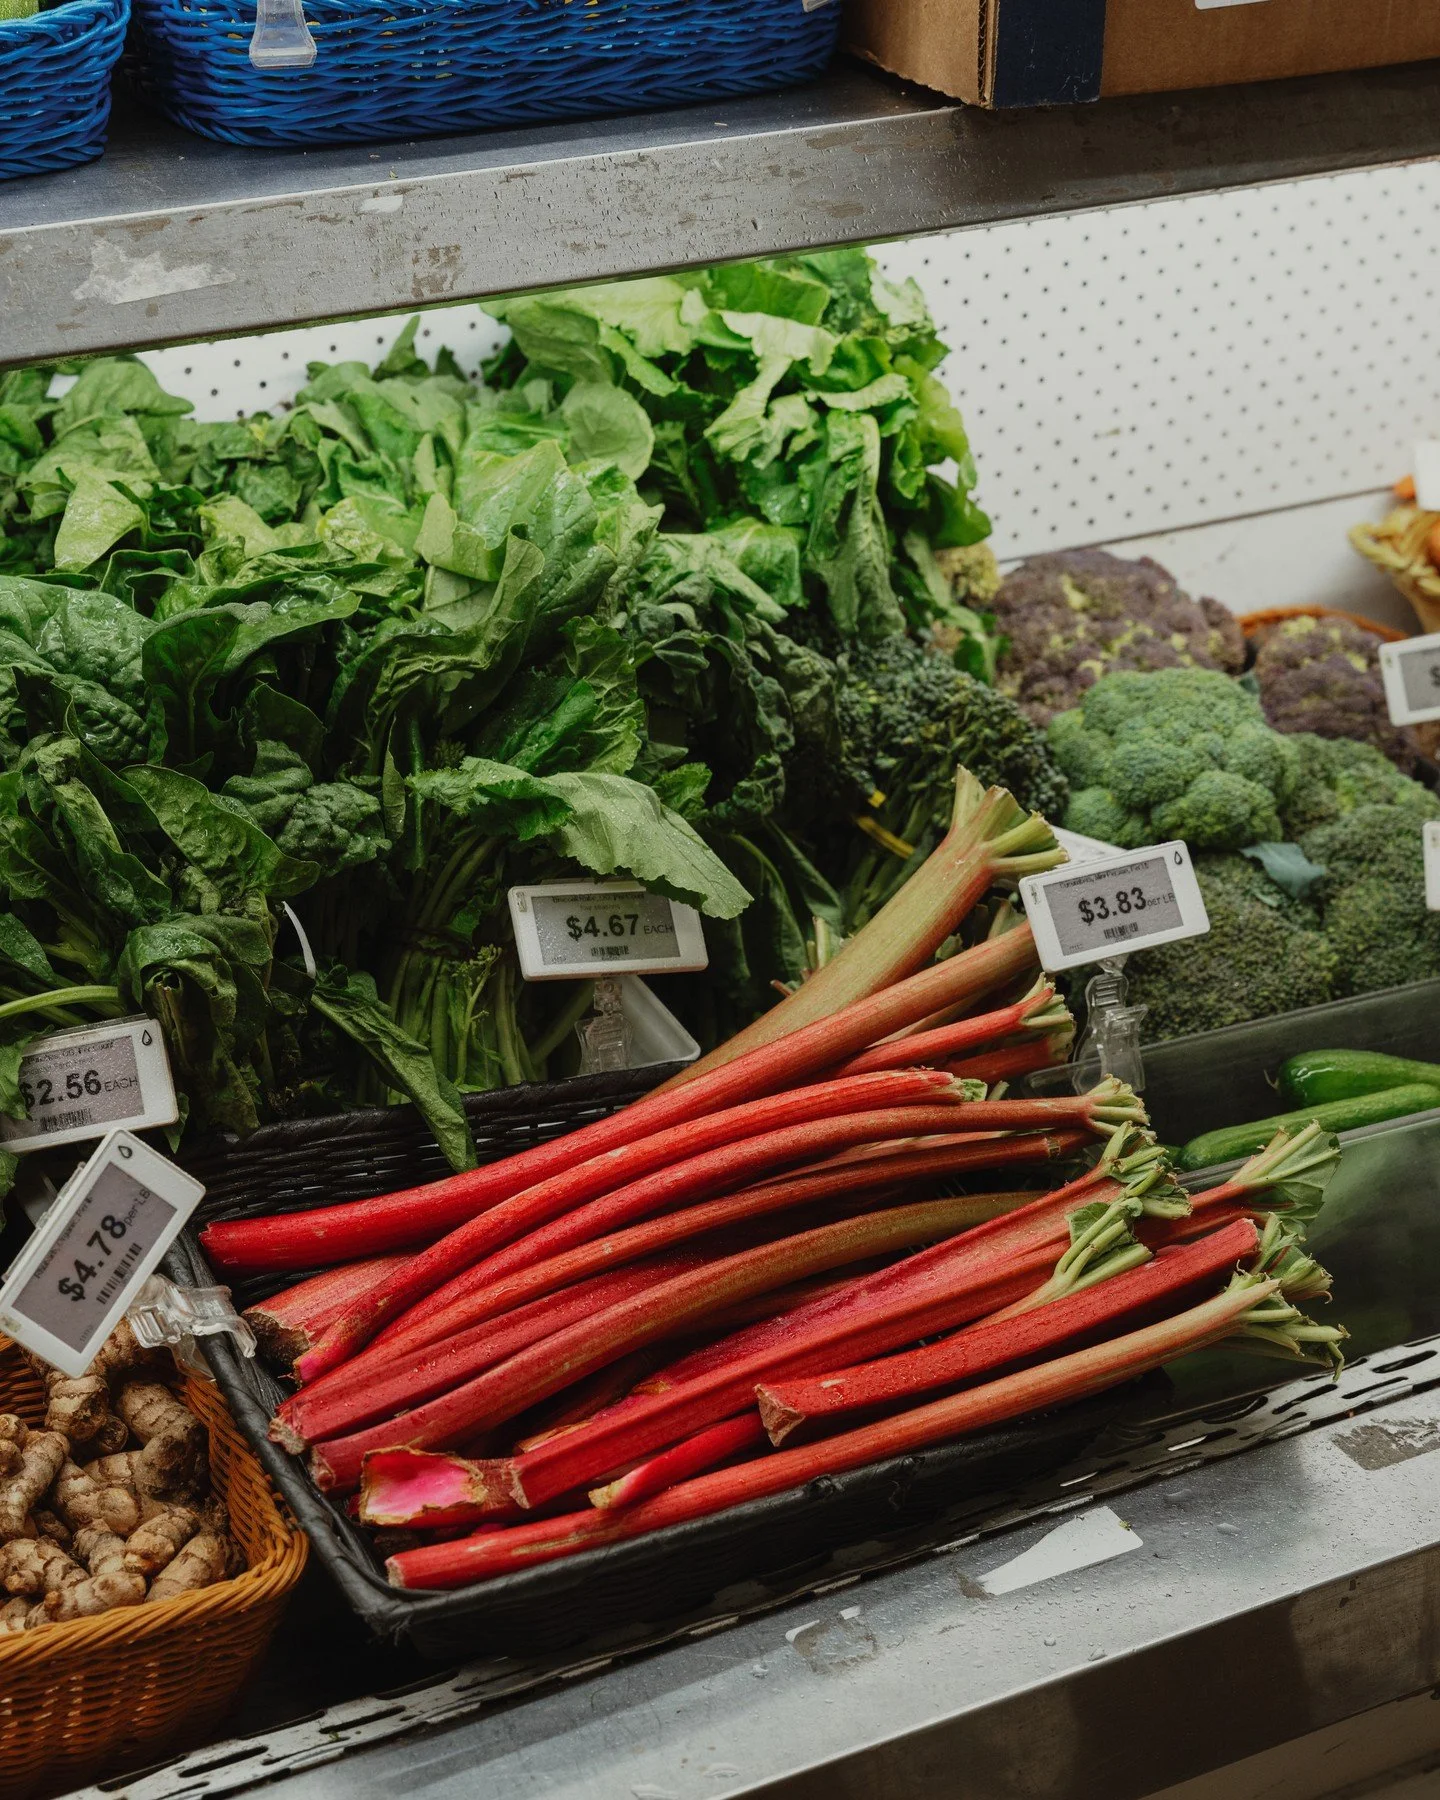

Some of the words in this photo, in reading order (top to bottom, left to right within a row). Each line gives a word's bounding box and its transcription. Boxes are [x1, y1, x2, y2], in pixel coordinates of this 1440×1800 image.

[566, 914, 639, 941] $4.67
[643, 925, 674, 935] EACH
[1078, 887, 1147, 927] $3.83
[19, 1069, 102, 1112] $2.56
[104, 1076, 138, 1093] EACH
[58, 1214, 127, 1302] $4.78
[124, 1198, 141, 1227] per
[138, 1188, 151, 1207] LB
